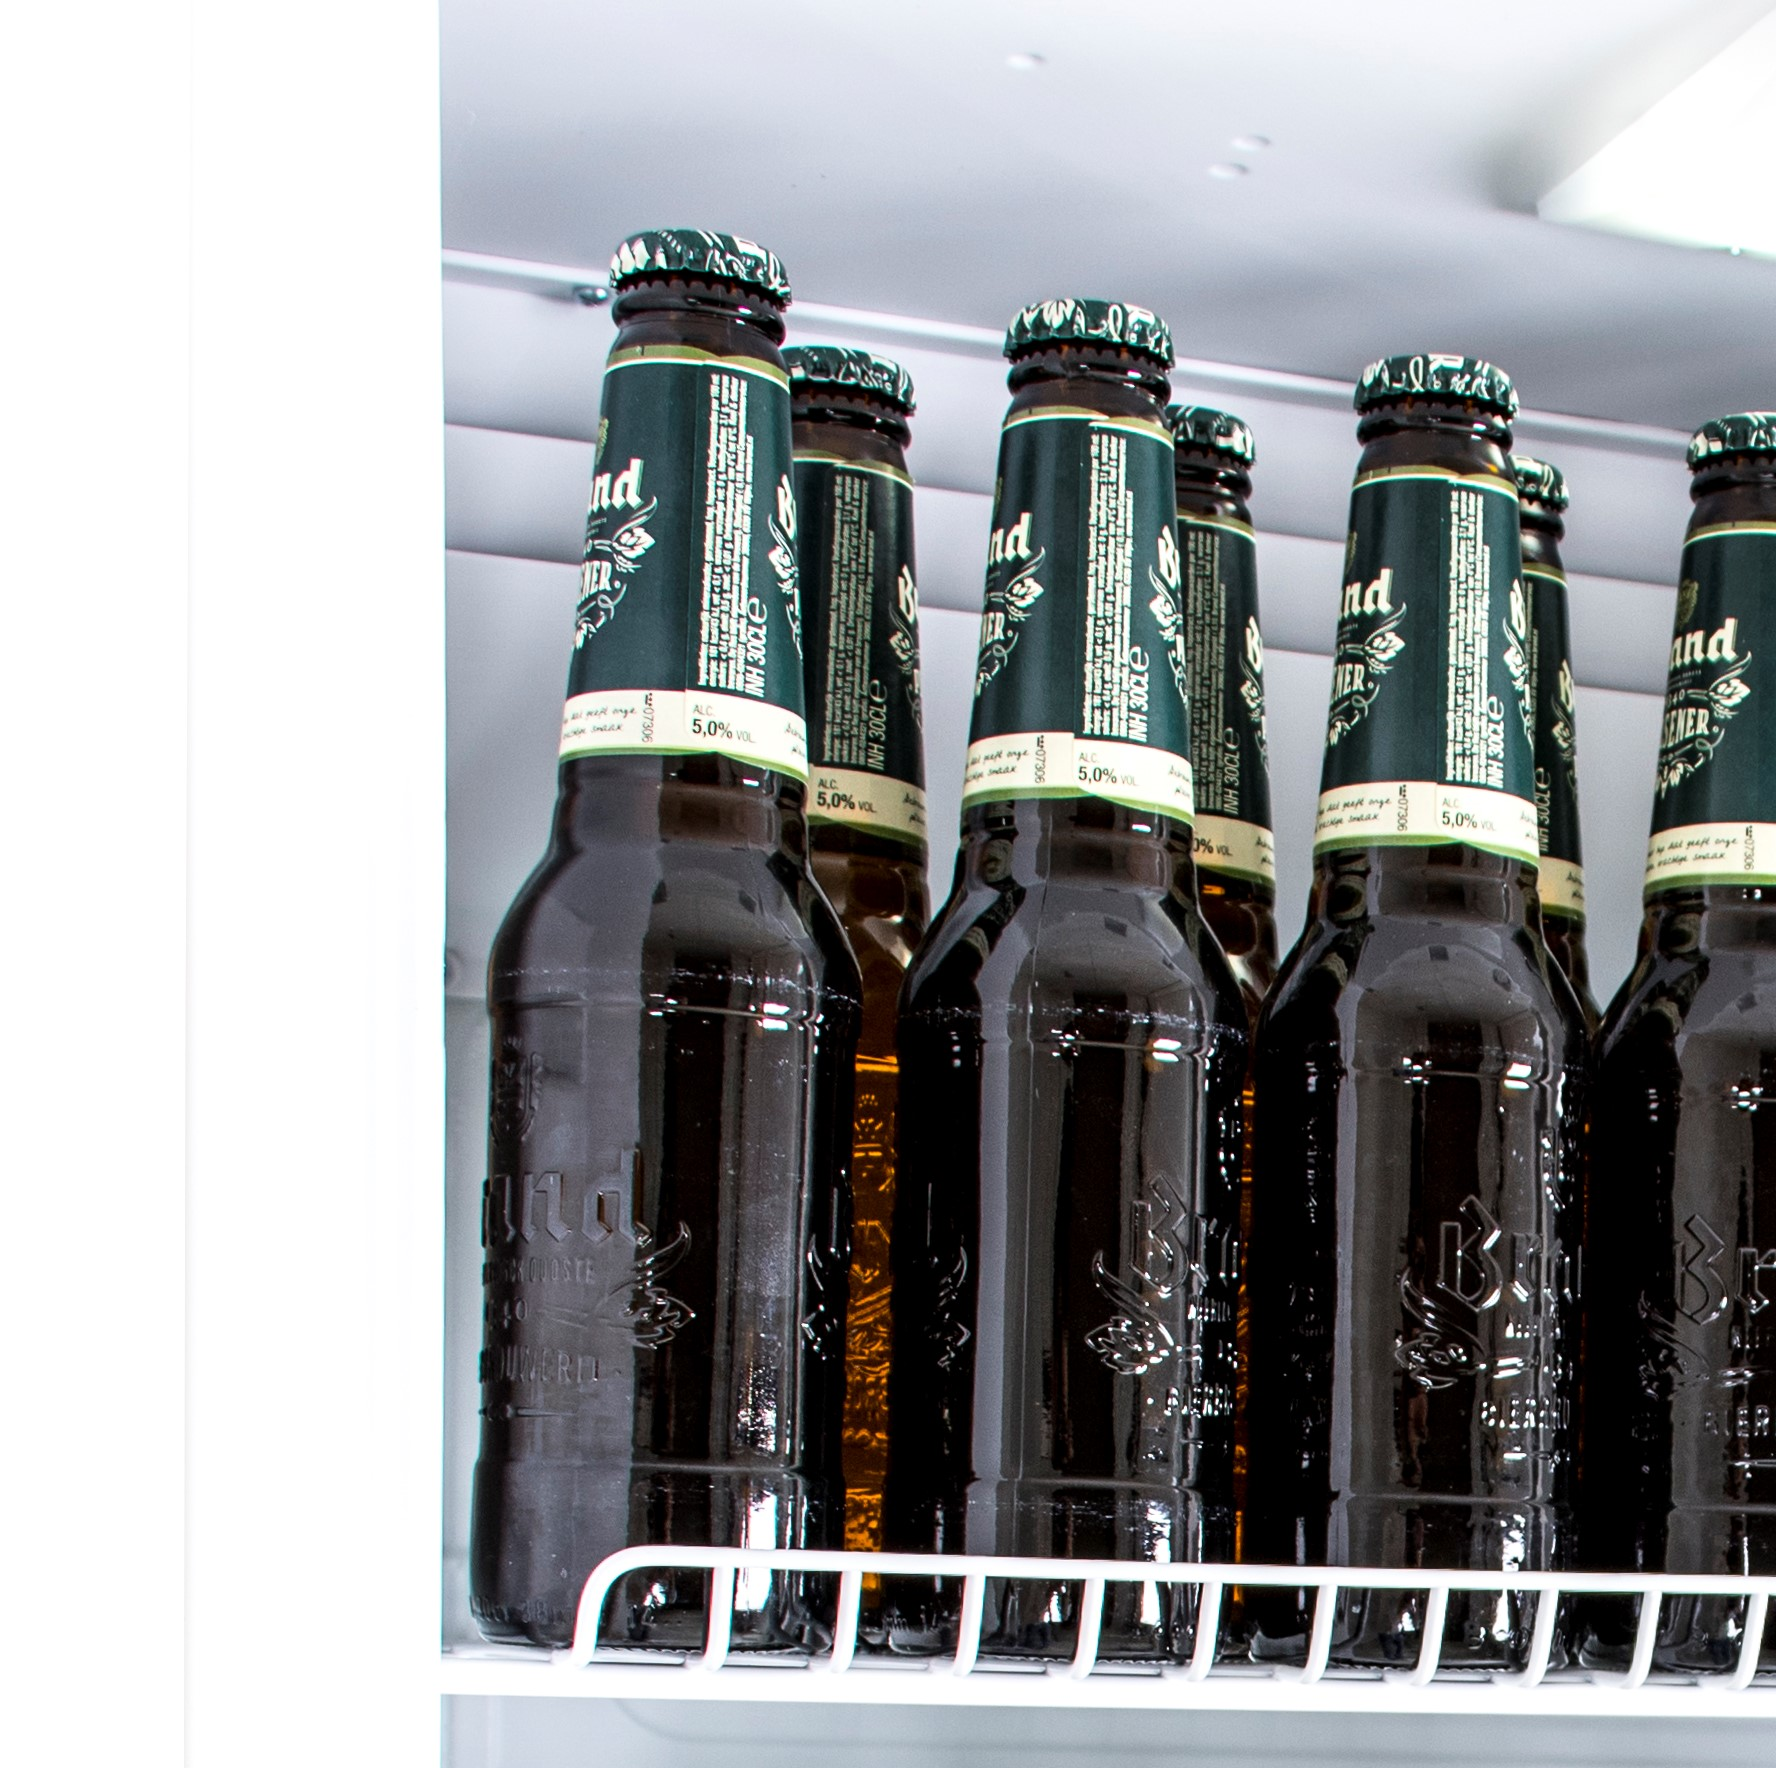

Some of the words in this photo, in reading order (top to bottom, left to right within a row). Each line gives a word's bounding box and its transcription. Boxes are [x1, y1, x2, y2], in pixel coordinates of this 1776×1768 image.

[587, 457, 645, 516] nd
[1338, 567, 1394, 622] nd
[745, 665, 765, 697] INH
[692, 718, 733, 739] 5,0%
[1128, 711, 1147, 743] INH
[867, 742, 885, 771] INH
[1078, 767, 1118, 785] 5,0%
[816, 791, 856, 810] 5,0%
[1223, 788, 1239, 815] INH
[1442, 811, 1478, 829] 5,0%
